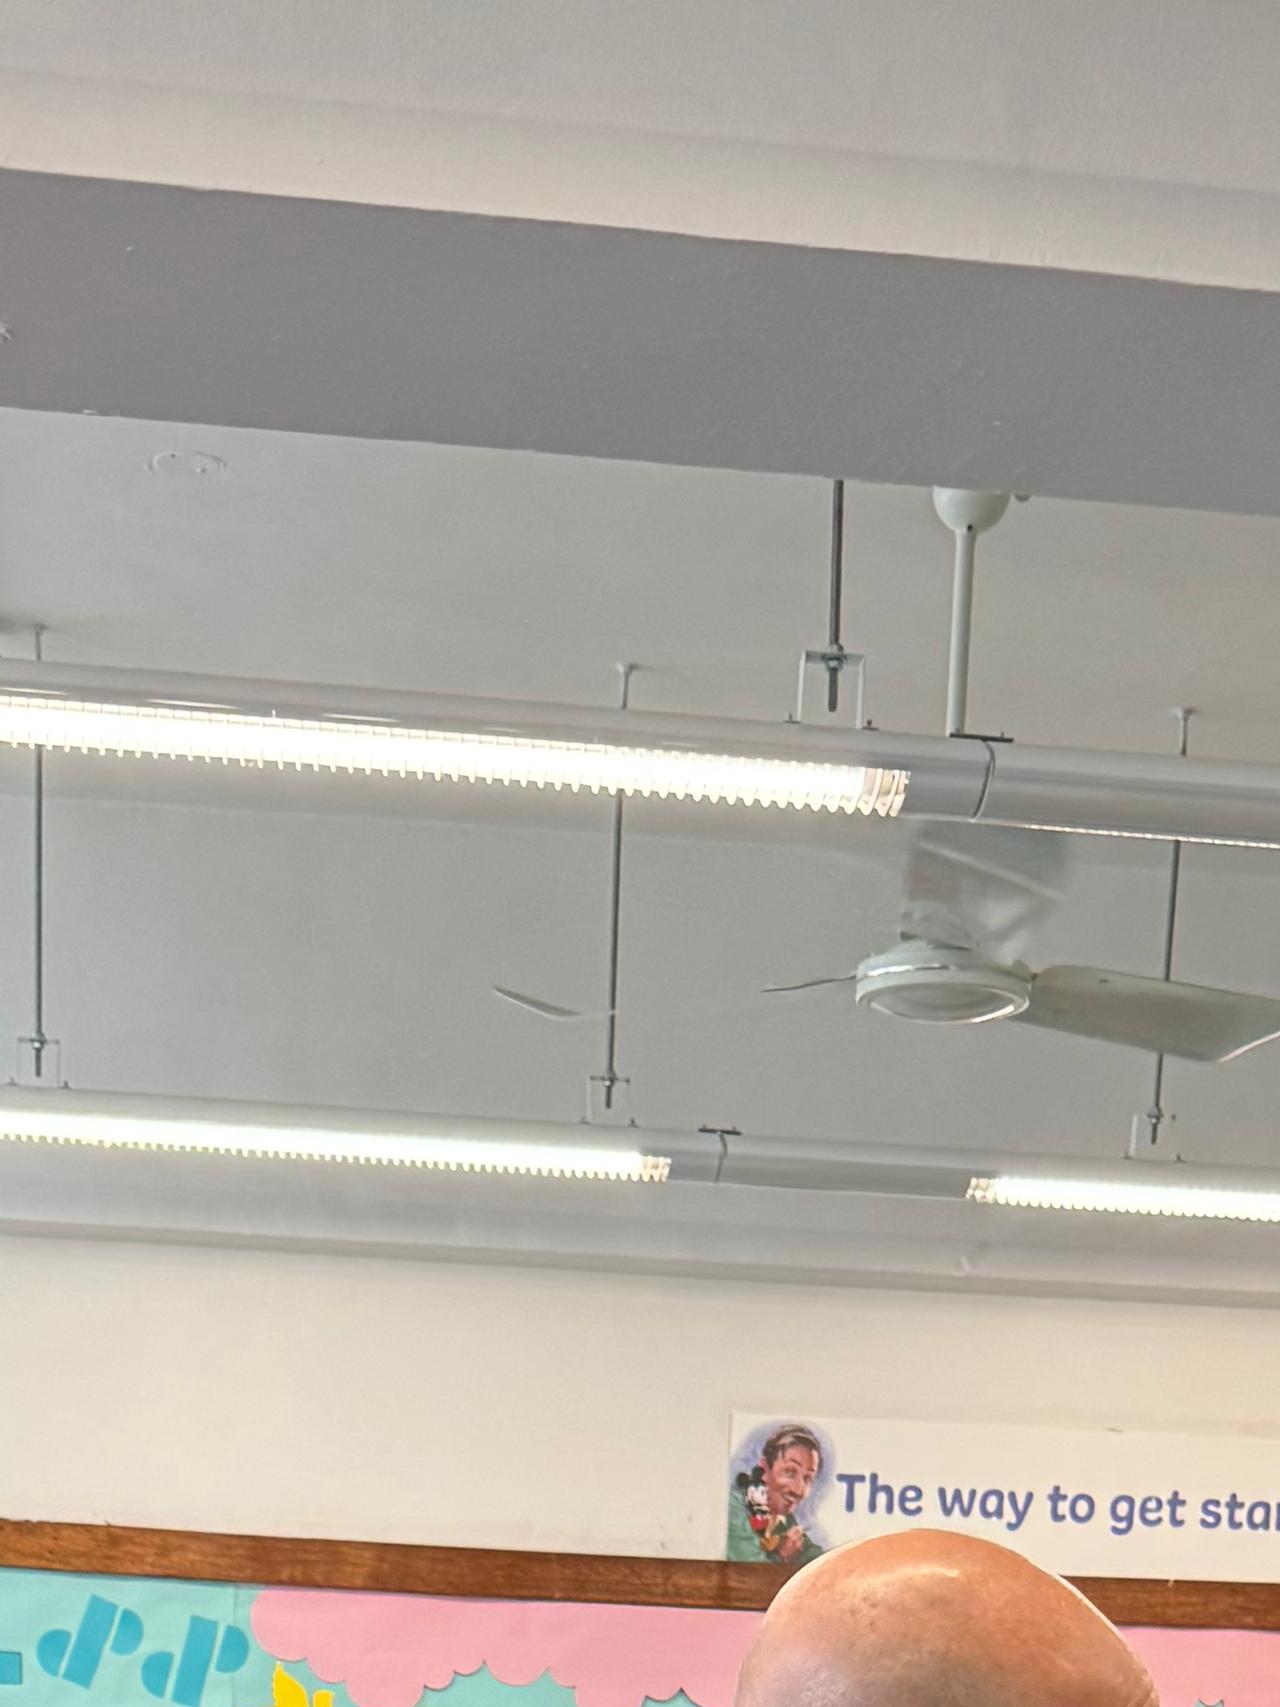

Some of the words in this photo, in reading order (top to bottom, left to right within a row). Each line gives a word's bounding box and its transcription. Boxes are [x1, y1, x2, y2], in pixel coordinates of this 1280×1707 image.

[836, 1473, 924, 1516] The
[938, 1487, 1034, 1531] way
[1048, 1483, 1096, 1525] to
[1109, 1488, 1185, 1535] get
